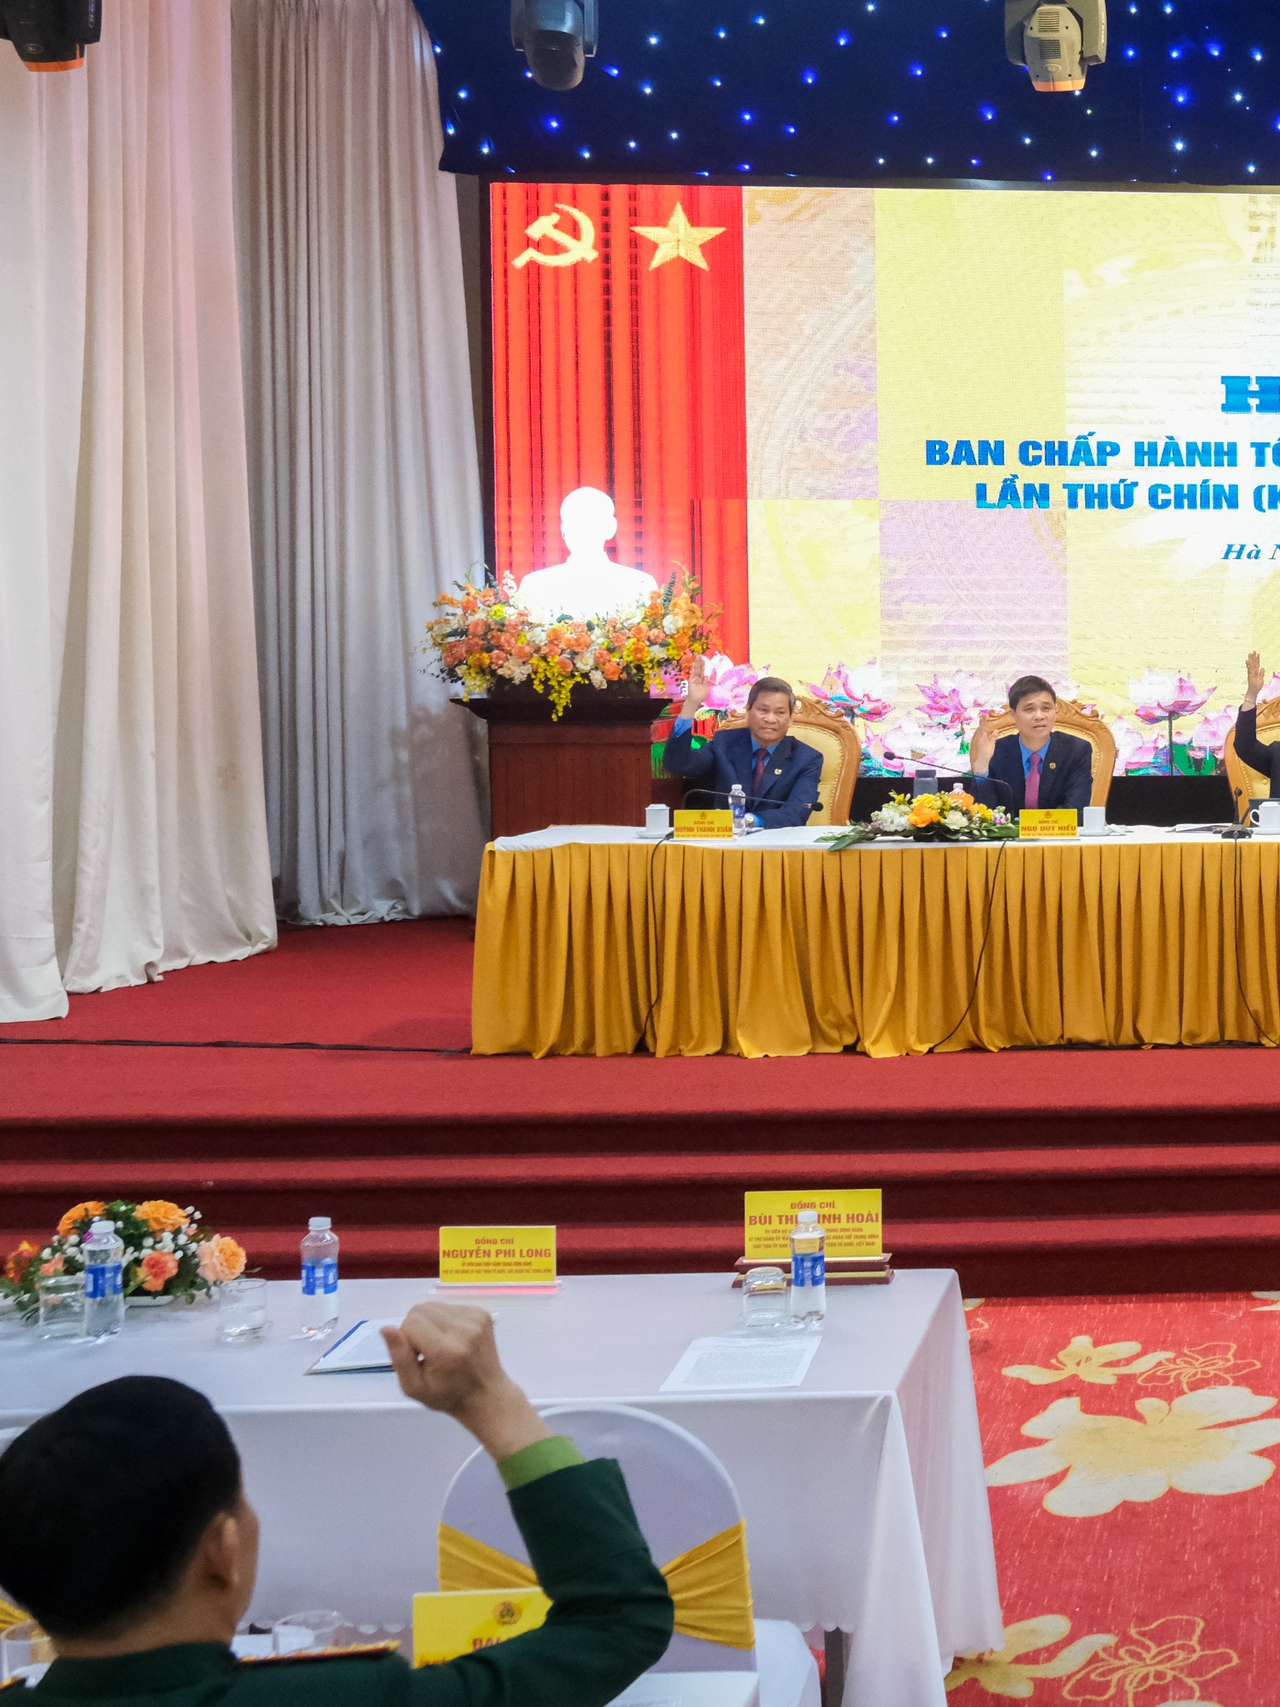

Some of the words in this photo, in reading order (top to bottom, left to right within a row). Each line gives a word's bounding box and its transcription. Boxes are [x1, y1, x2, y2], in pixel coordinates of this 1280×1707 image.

[926, 440, 1004, 466] BAN
[1019, 432, 1120, 467] CHẤP
[1134, 436, 1238, 468] HÀNH
[975, 474, 1050, 510] LẦN
[1062, 479, 1139, 510] THỨ
[1148, 479, 1239, 510] CHÍN
[1221, 543, 1261, 560] Hà
[819, 1200, 835, 1209] CHÍ
[748, 1212, 773, 1226] BÙI
[846, 1211, 879, 1224] HOÀI
[500, 1236, 514, 1245] CHÍ
[441, 1246, 492, 1259] NGUYỄN
[495, 1248, 516, 1258] PHI
[519, 1248, 552, 1258] LONG
